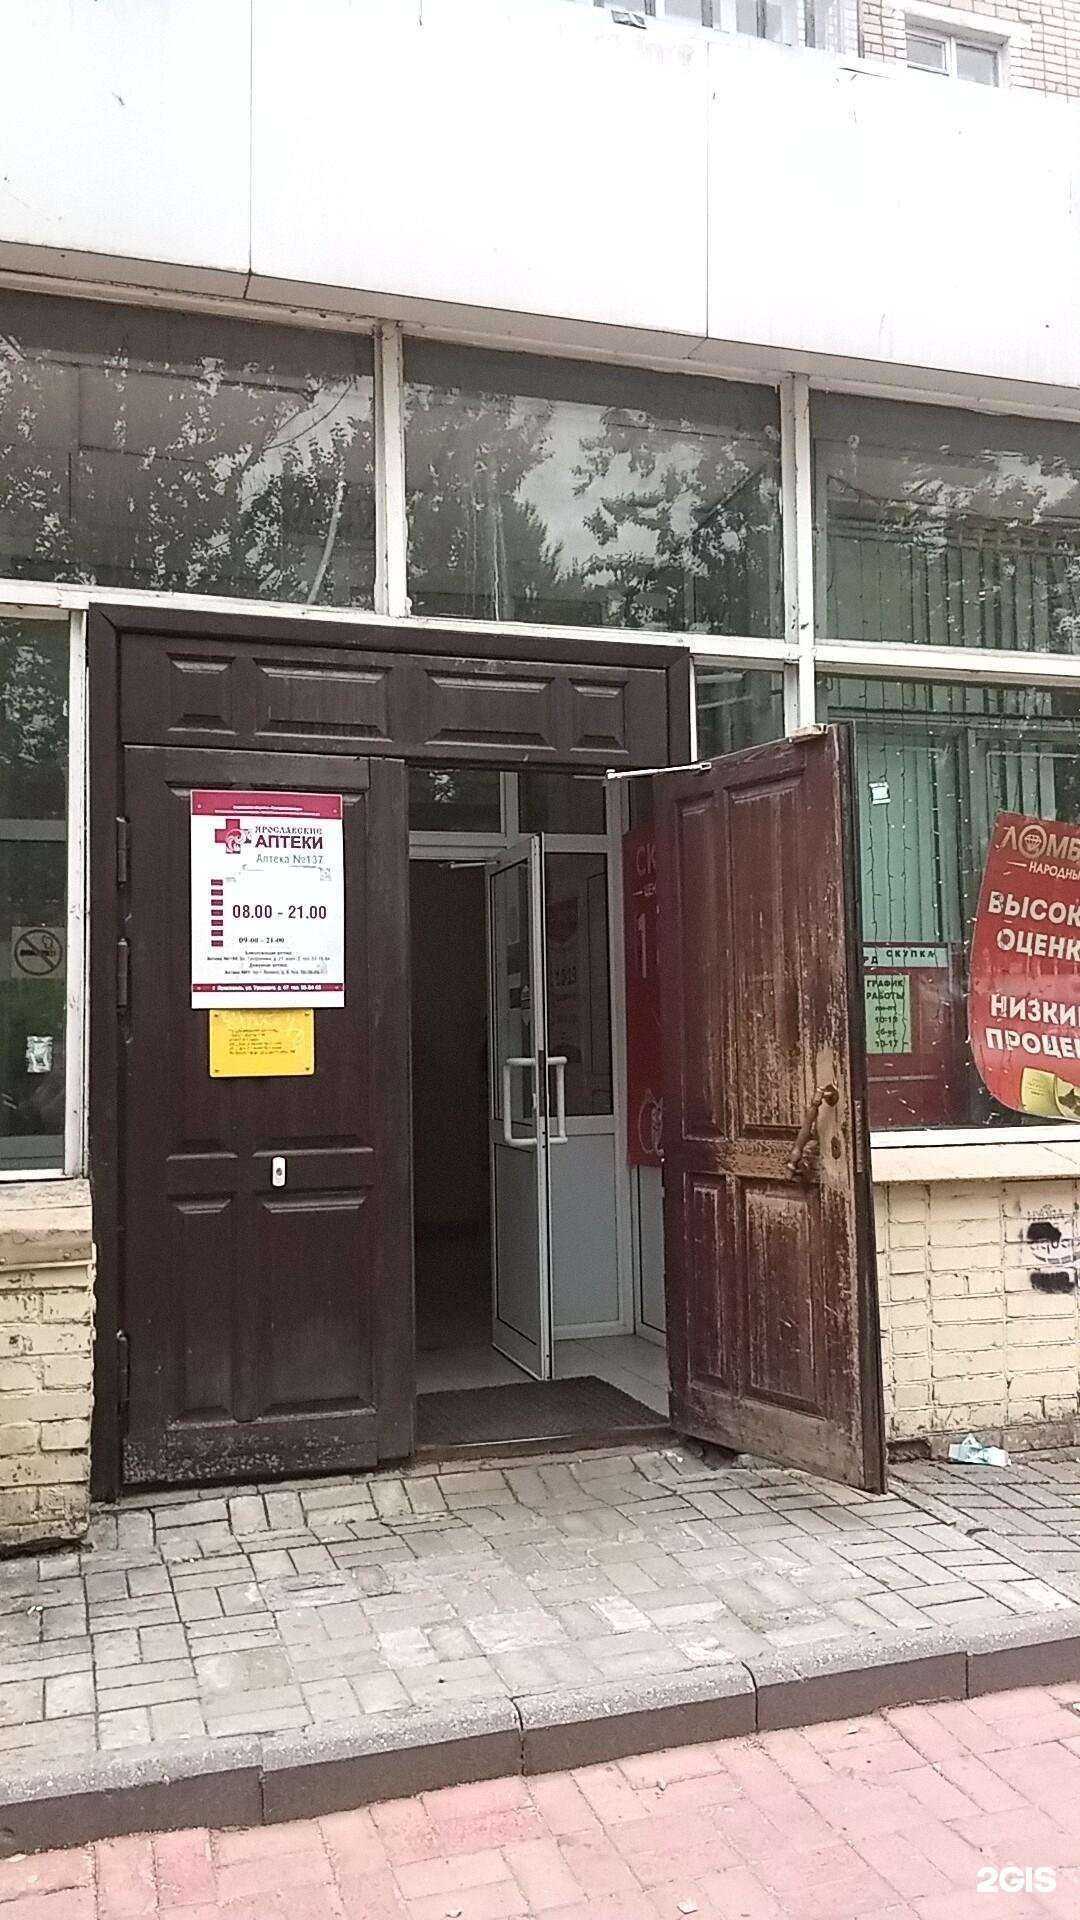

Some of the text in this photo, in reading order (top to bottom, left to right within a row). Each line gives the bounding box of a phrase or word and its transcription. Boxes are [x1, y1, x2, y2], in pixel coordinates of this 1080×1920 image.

[255, 835, 323, 849] АПТЕКИ
[256, 854, 290, 864] Аптека
[232, 904, 273, 919] 08.00
[288, 905, 327, 920] 21.00
[866, 992, 904, 1000] РАБОТЫ
